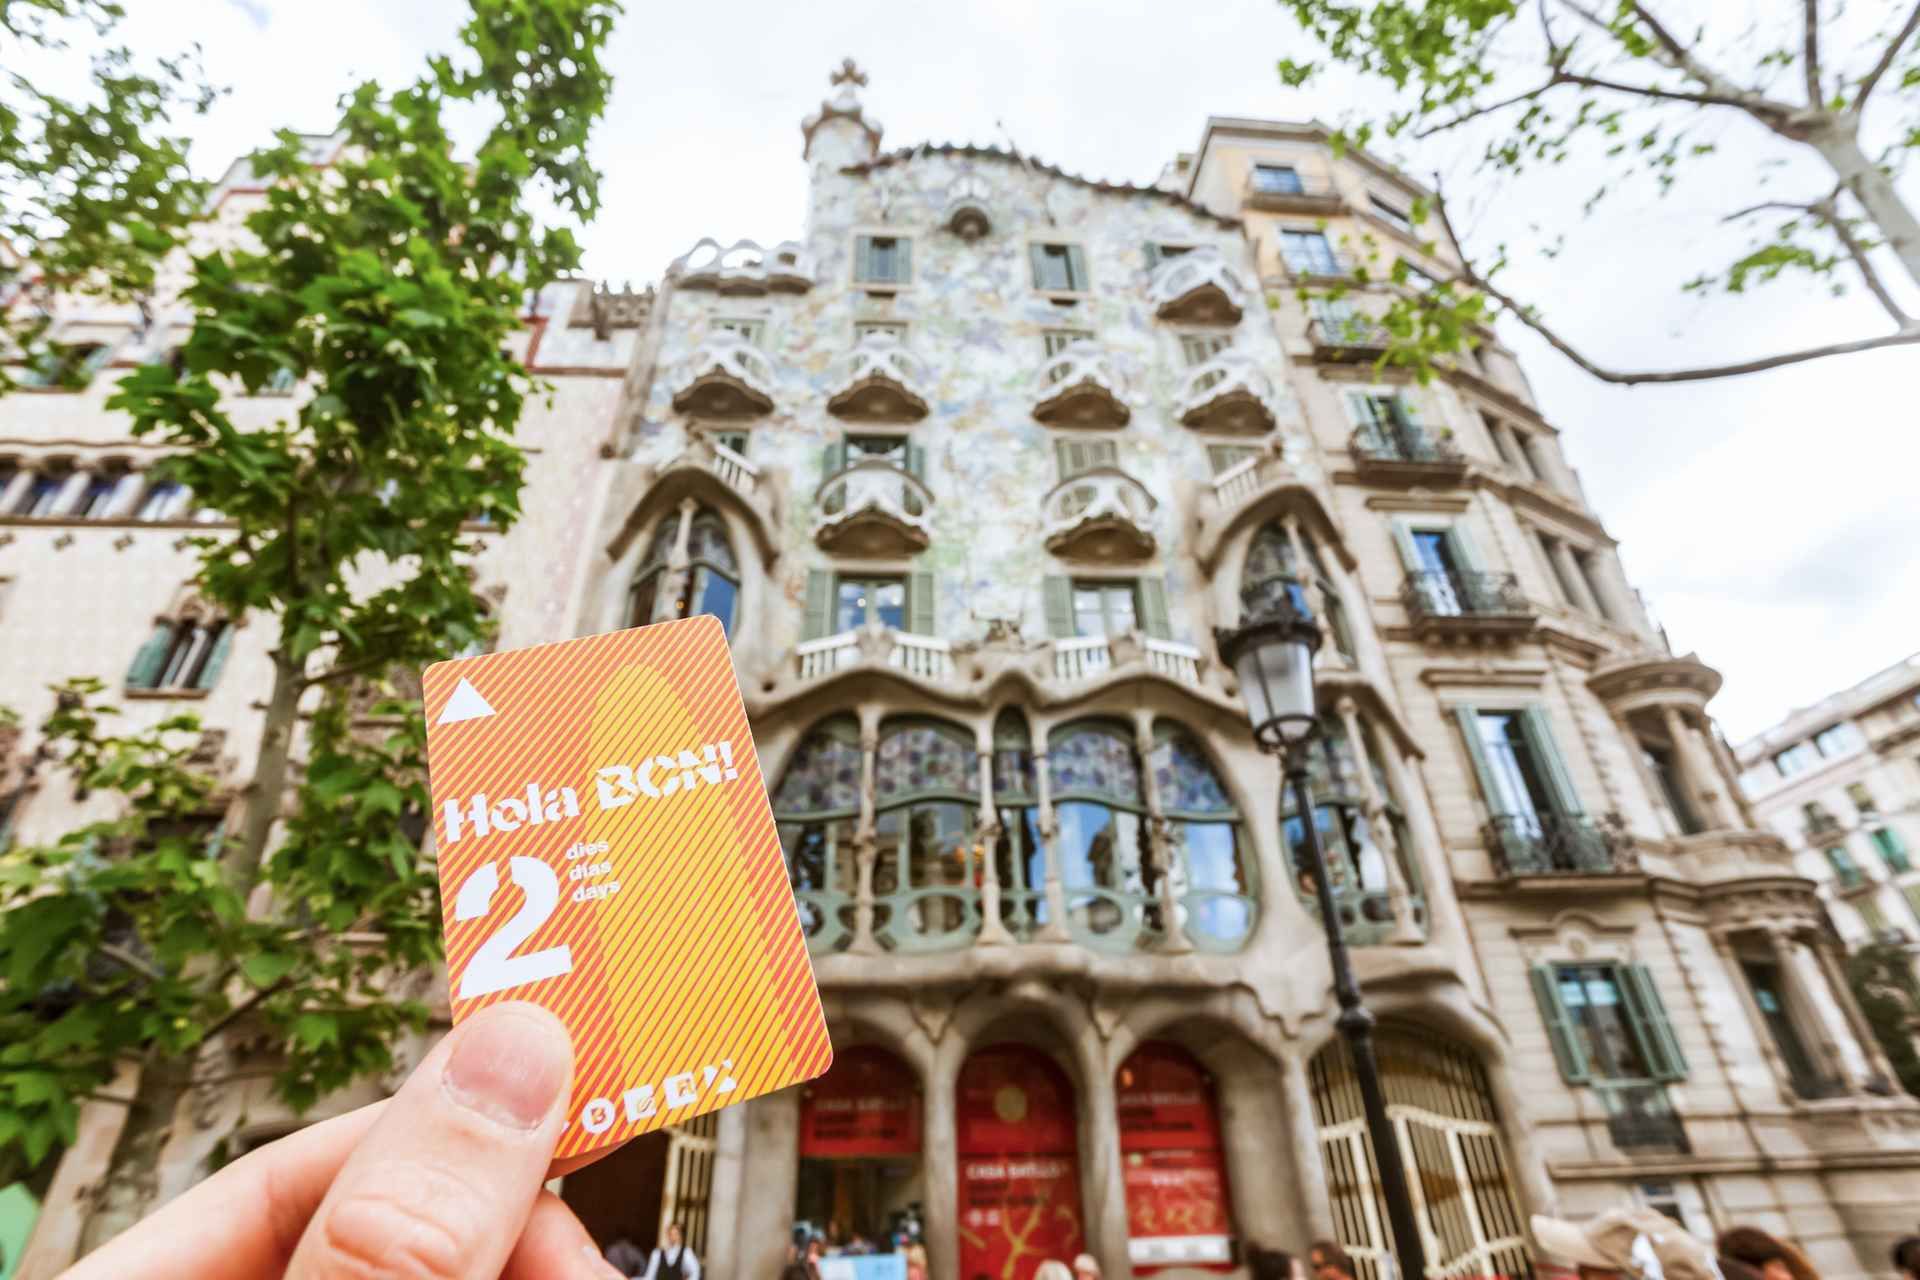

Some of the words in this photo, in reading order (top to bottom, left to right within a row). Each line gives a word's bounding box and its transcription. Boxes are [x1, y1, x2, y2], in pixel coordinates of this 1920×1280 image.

[443, 782, 580, 843] Hola
[596, 741, 738, 810] BCN!
[566, 842, 609, 860] dies
[573, 881, 620, 902] days
[455, 855, 573, 1000] 2
